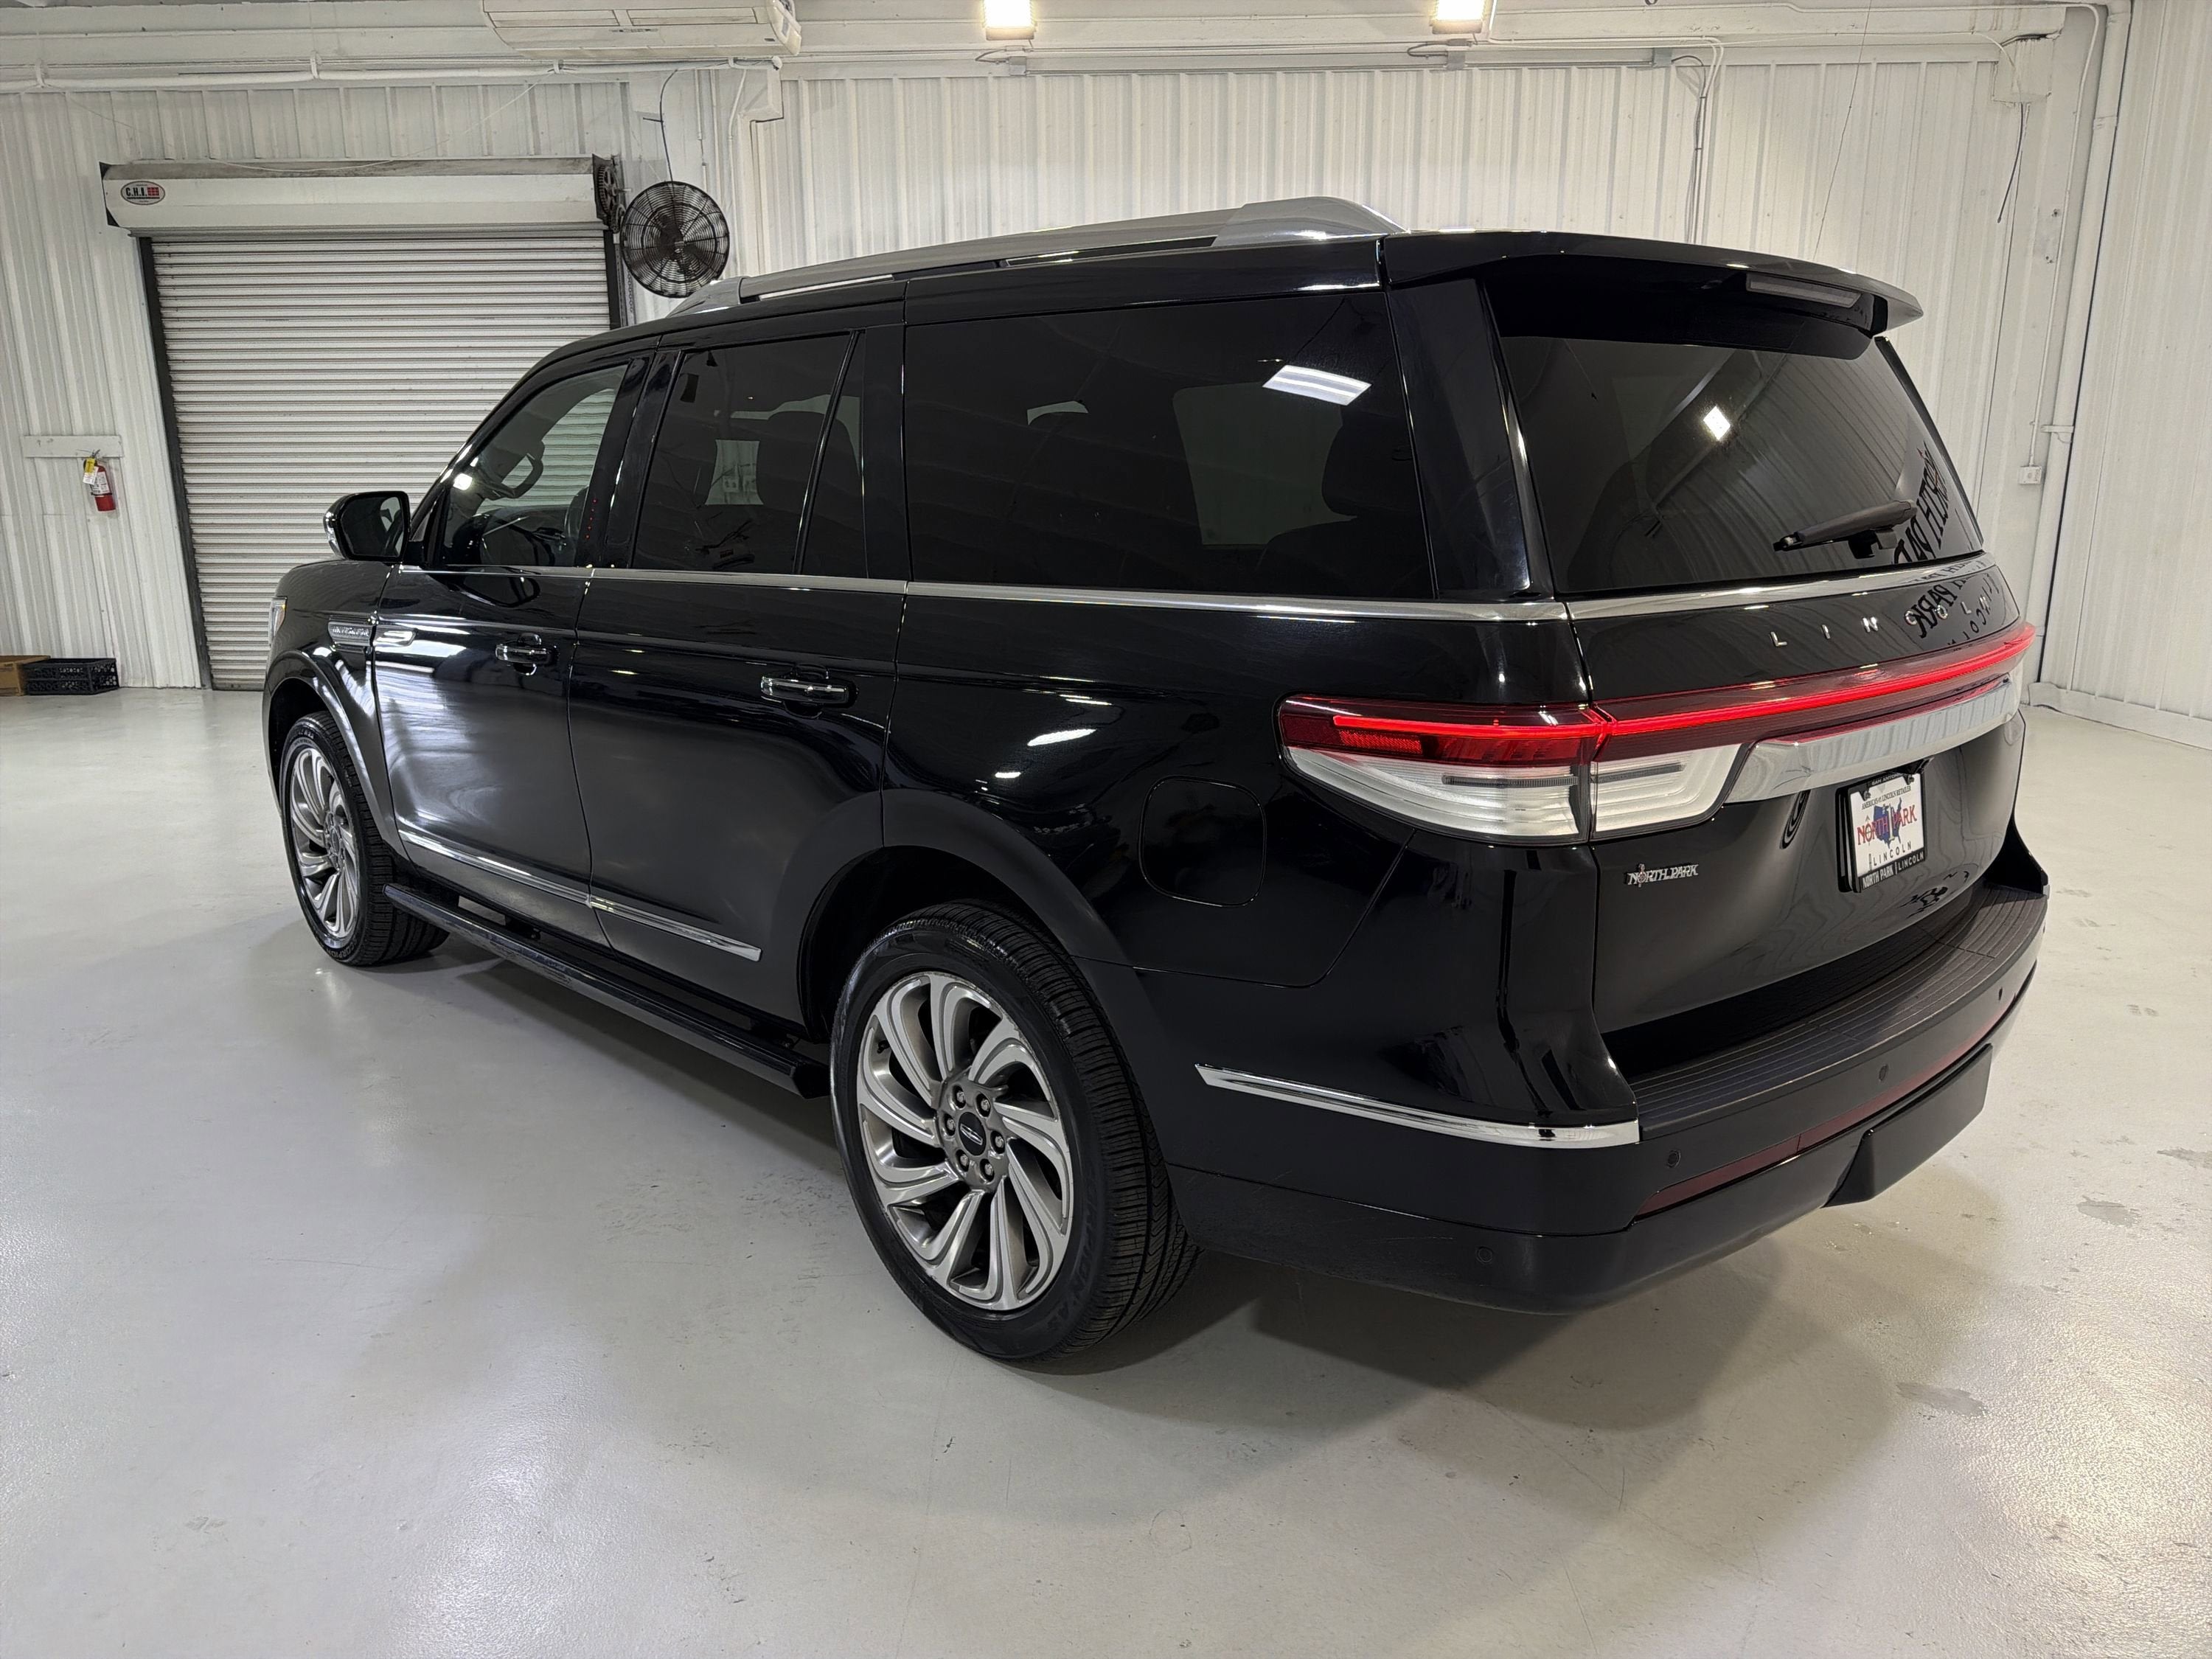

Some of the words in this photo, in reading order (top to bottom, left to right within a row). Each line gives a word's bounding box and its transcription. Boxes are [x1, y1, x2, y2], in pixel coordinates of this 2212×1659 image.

[1770, 596, 1988, 647] LINCOLN
[1857, 815, 1888, 845] NORTH
[1892, 804, 1917, 829] PARK
[1862, 869, 1879, 889] NORTH
[1879, 864, 1894, 881] PARK
[1898, 852, 1924, 870] LINCOLN
[1874, 841, 1912, 866] LINCOLN
